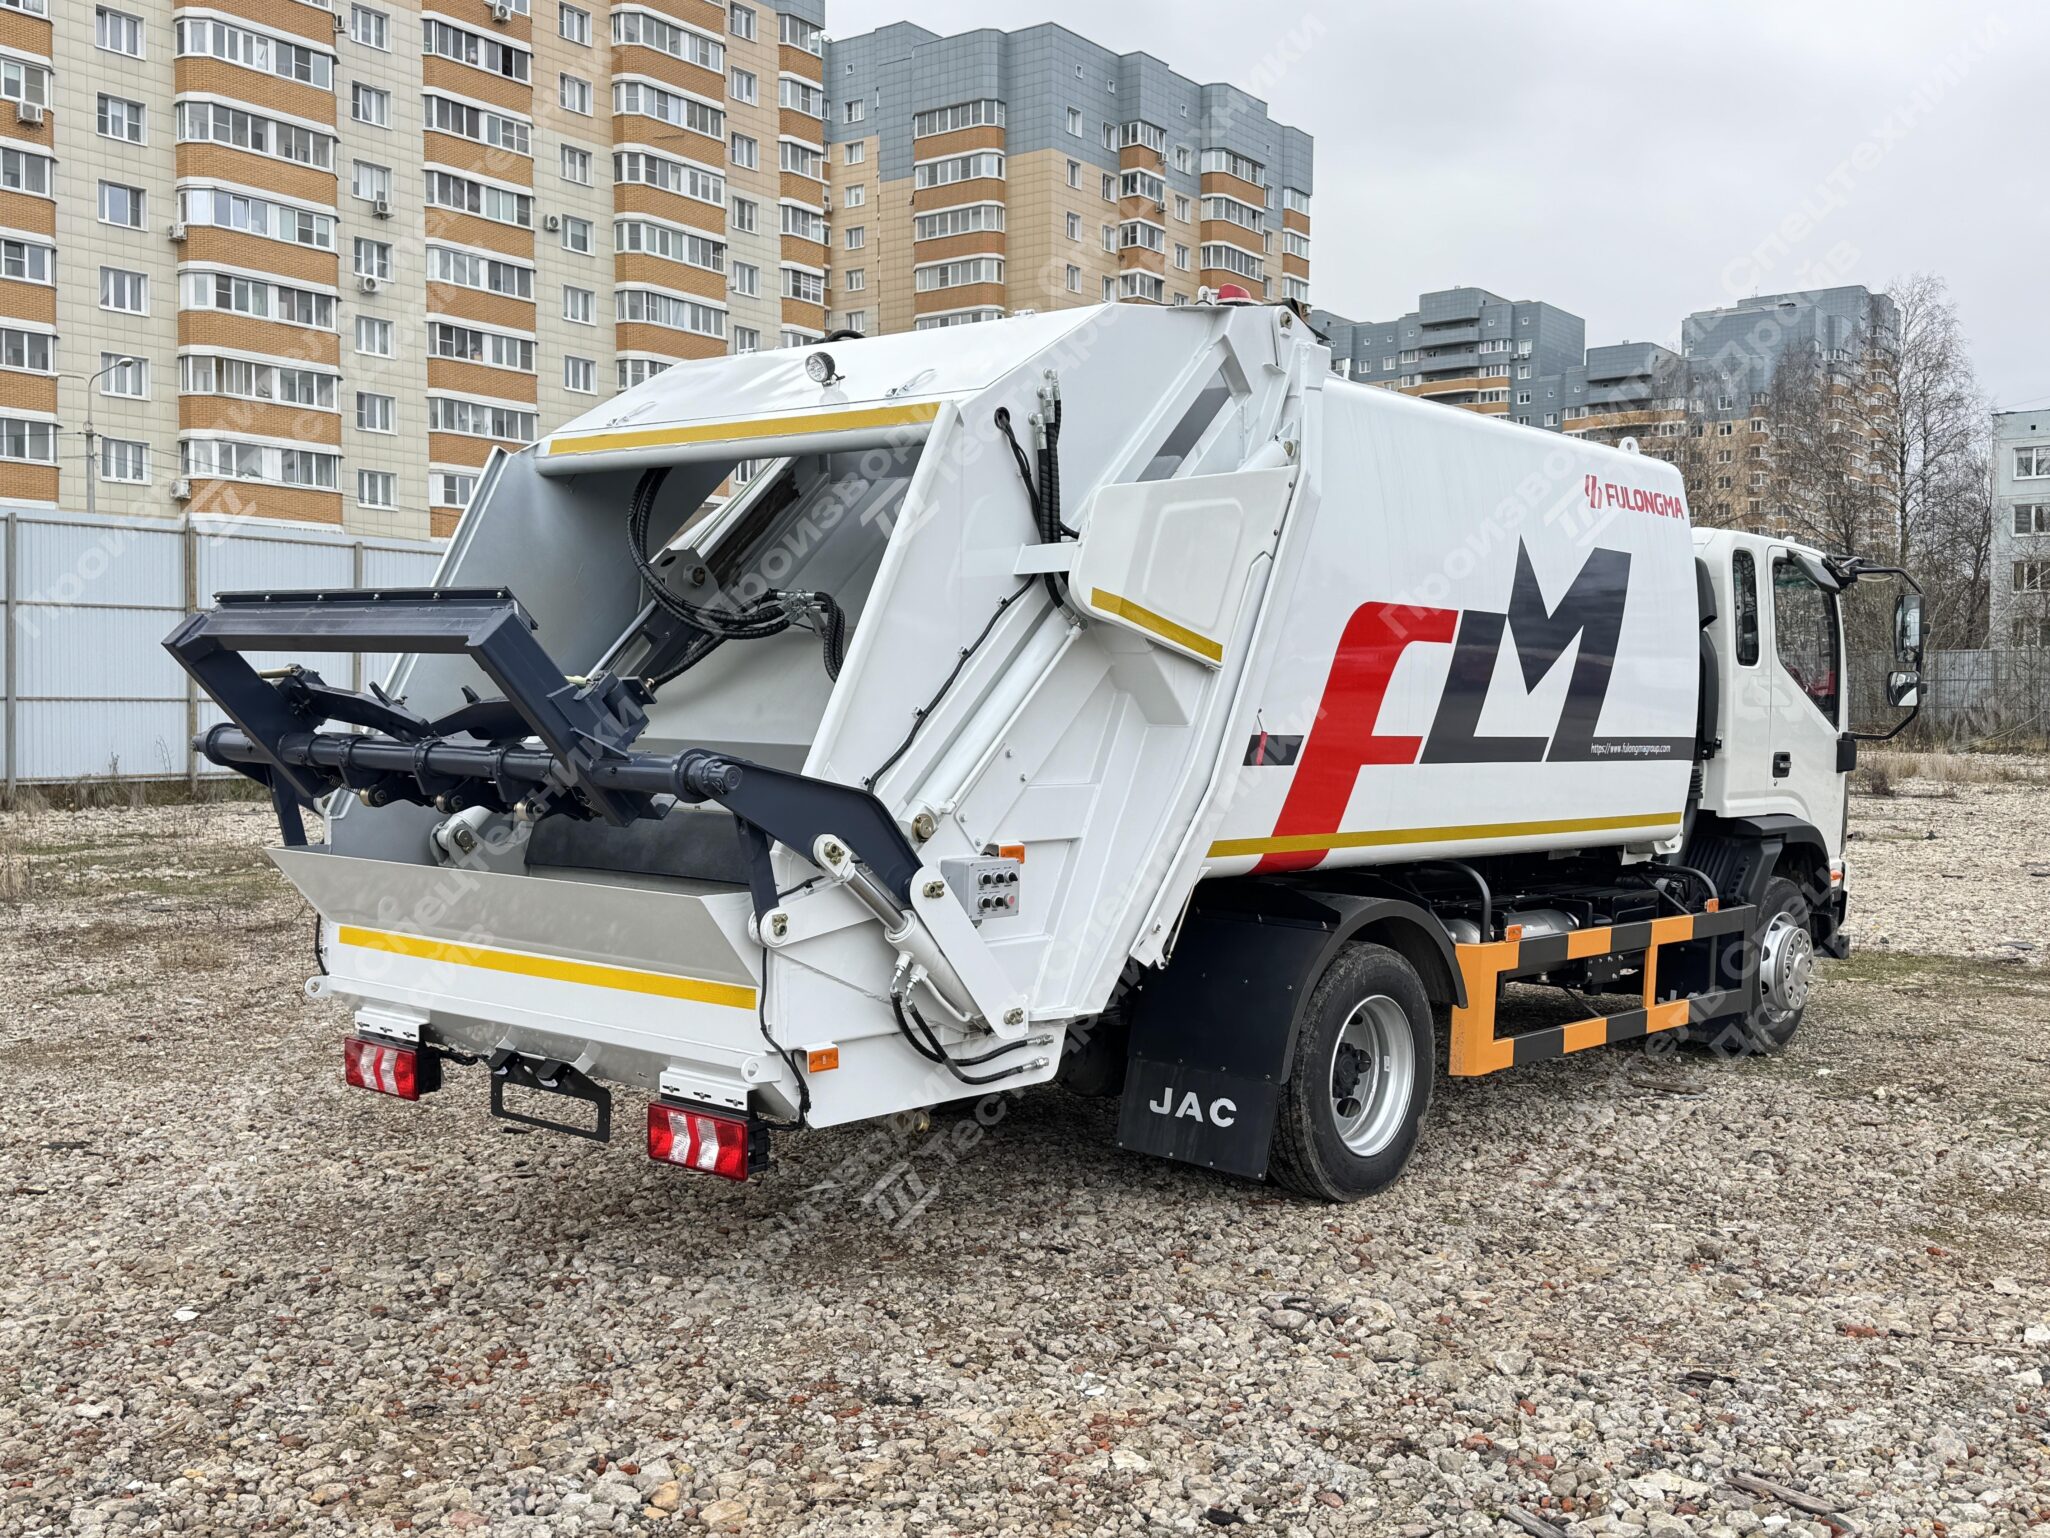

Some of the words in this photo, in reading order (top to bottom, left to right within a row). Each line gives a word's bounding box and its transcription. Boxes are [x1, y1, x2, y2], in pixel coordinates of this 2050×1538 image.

[1605, 483, 1684, 520] FULONGMA
[1591, 743, 1671, 756] https://www.fulongmagroup.com
[1149, 1087, 1237, 1128] JAC
